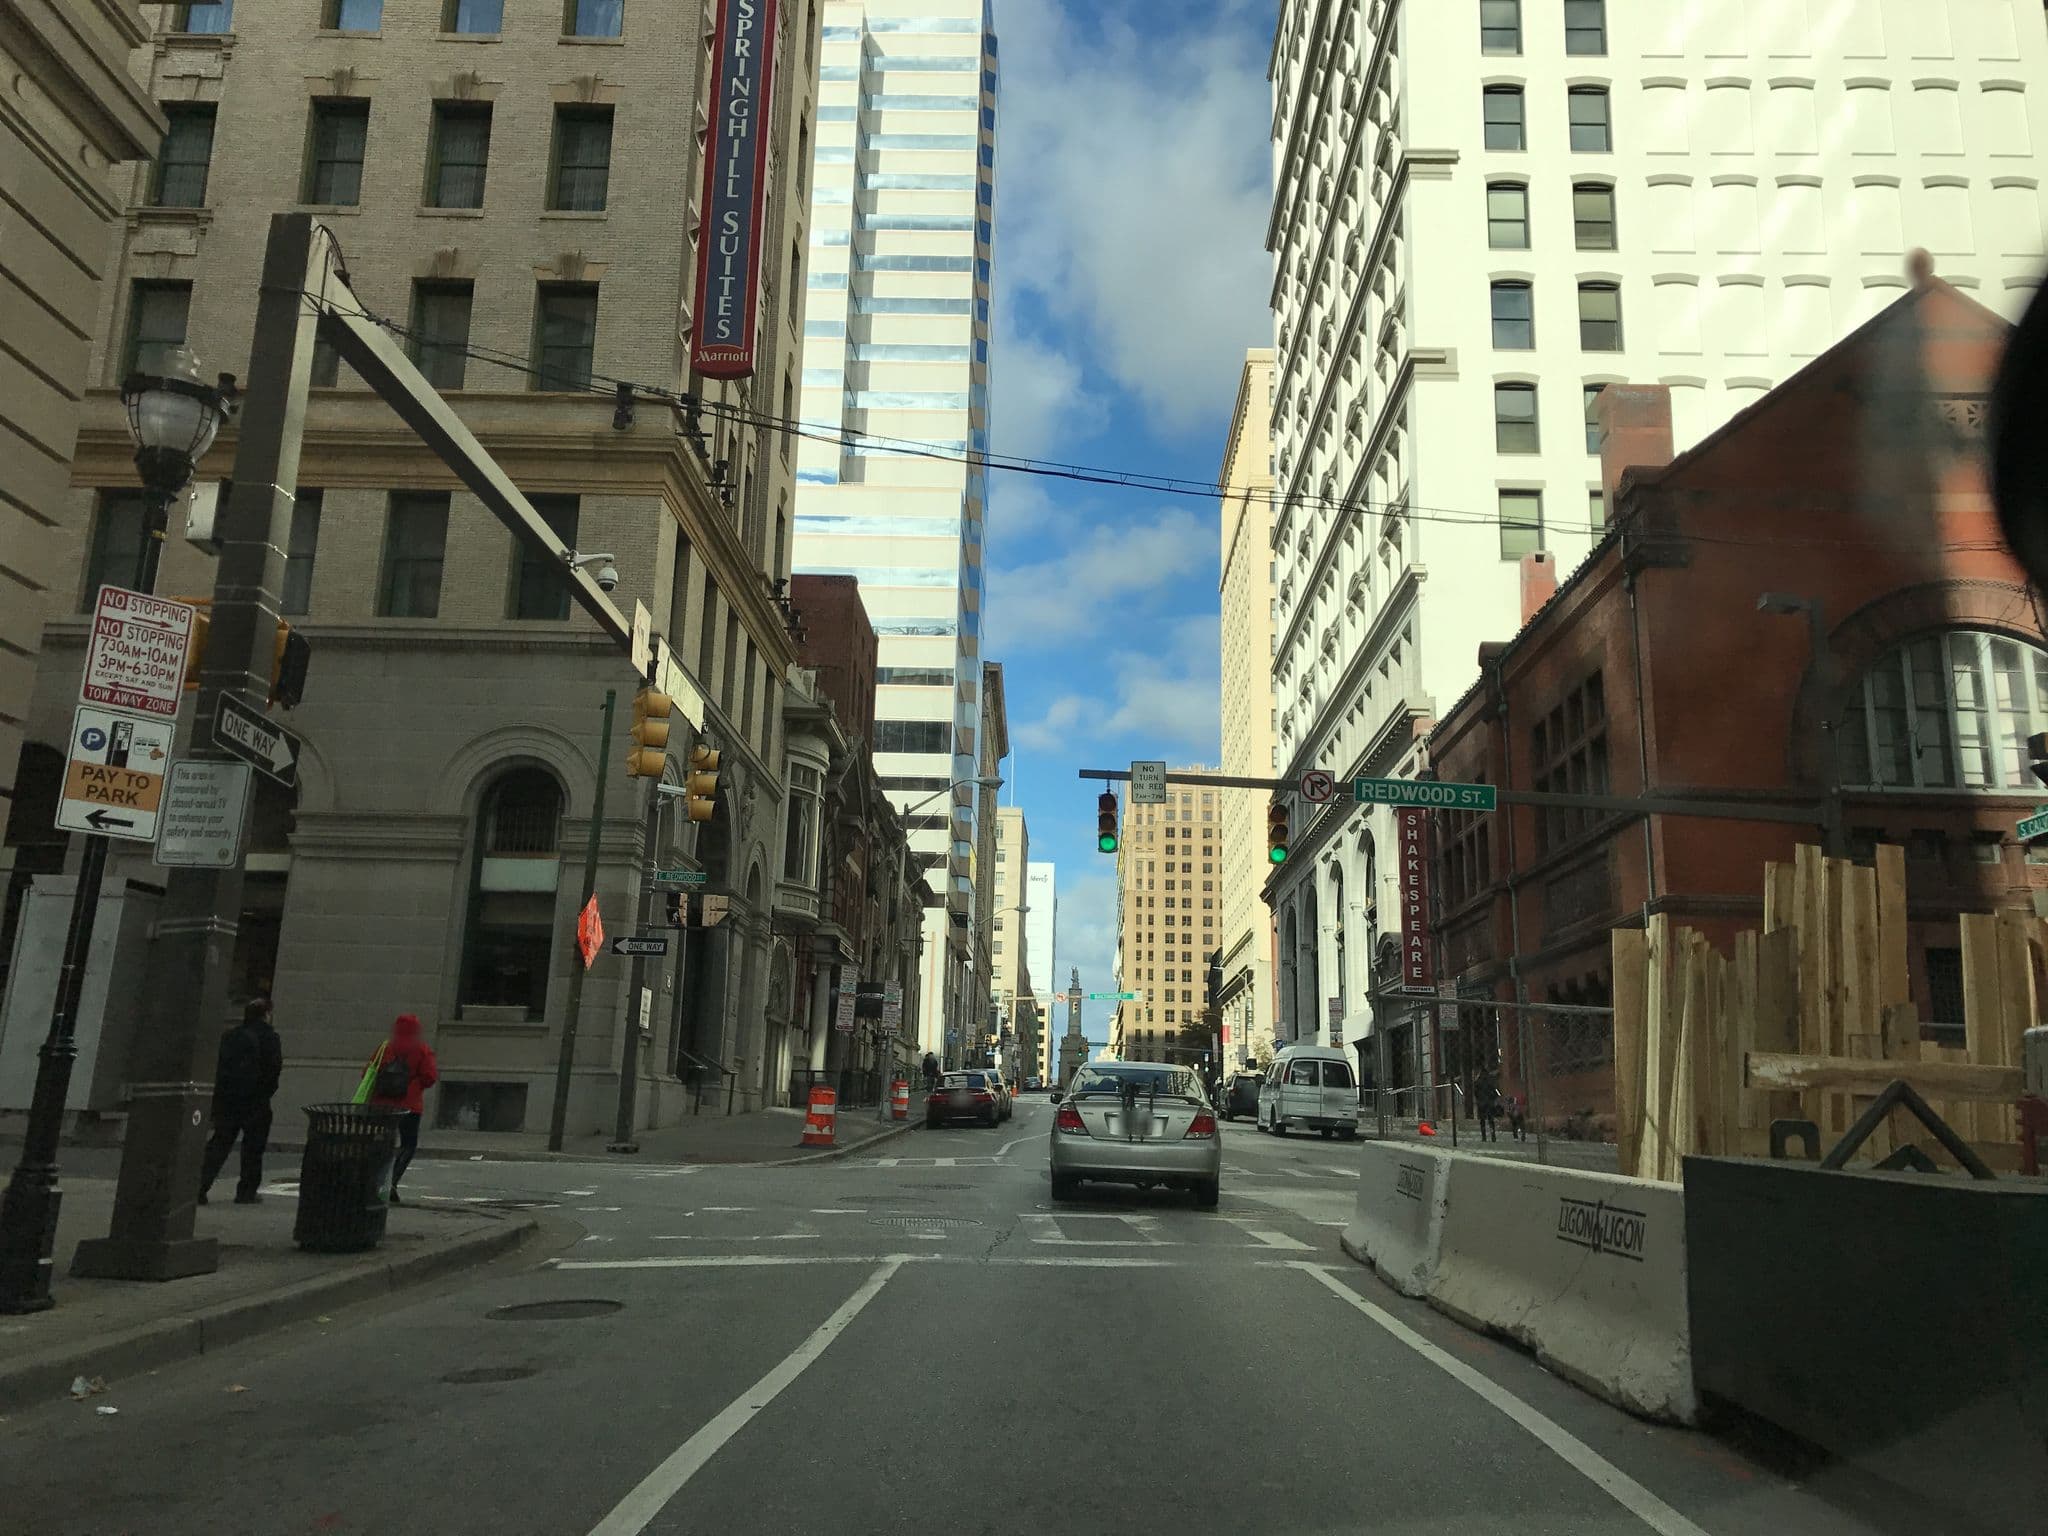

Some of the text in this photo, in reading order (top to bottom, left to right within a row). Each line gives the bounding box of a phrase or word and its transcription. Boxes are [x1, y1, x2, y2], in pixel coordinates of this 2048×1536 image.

[716, 0, 754, 339] SPRINGHILL SUITES
[695, 350, 749, 362] Marriott
[104, 589, 188, 623] NO STOPPING
[99, 619, 184, 650] NO STOPPING
[95, 669, 123, 681] EXCEPT
[141, 679, 156, 688] AND
[158, 682, 174, 691] SUN
[88, 686, 174, 713] TOW AWAY ZONE
[225, 713, 276, 757] ONE WAY
[81, 765, 150, 790] PAY TO
[1142, 765, 1155, 773] NO
[86, 784, 140, 806] PARK
[1361, 782, 1486, 805] REDWOOD ST.
[1406, 815, 1422, 978] SHAKESPEARE
[628, 942, 662, 951] ONE WAY
